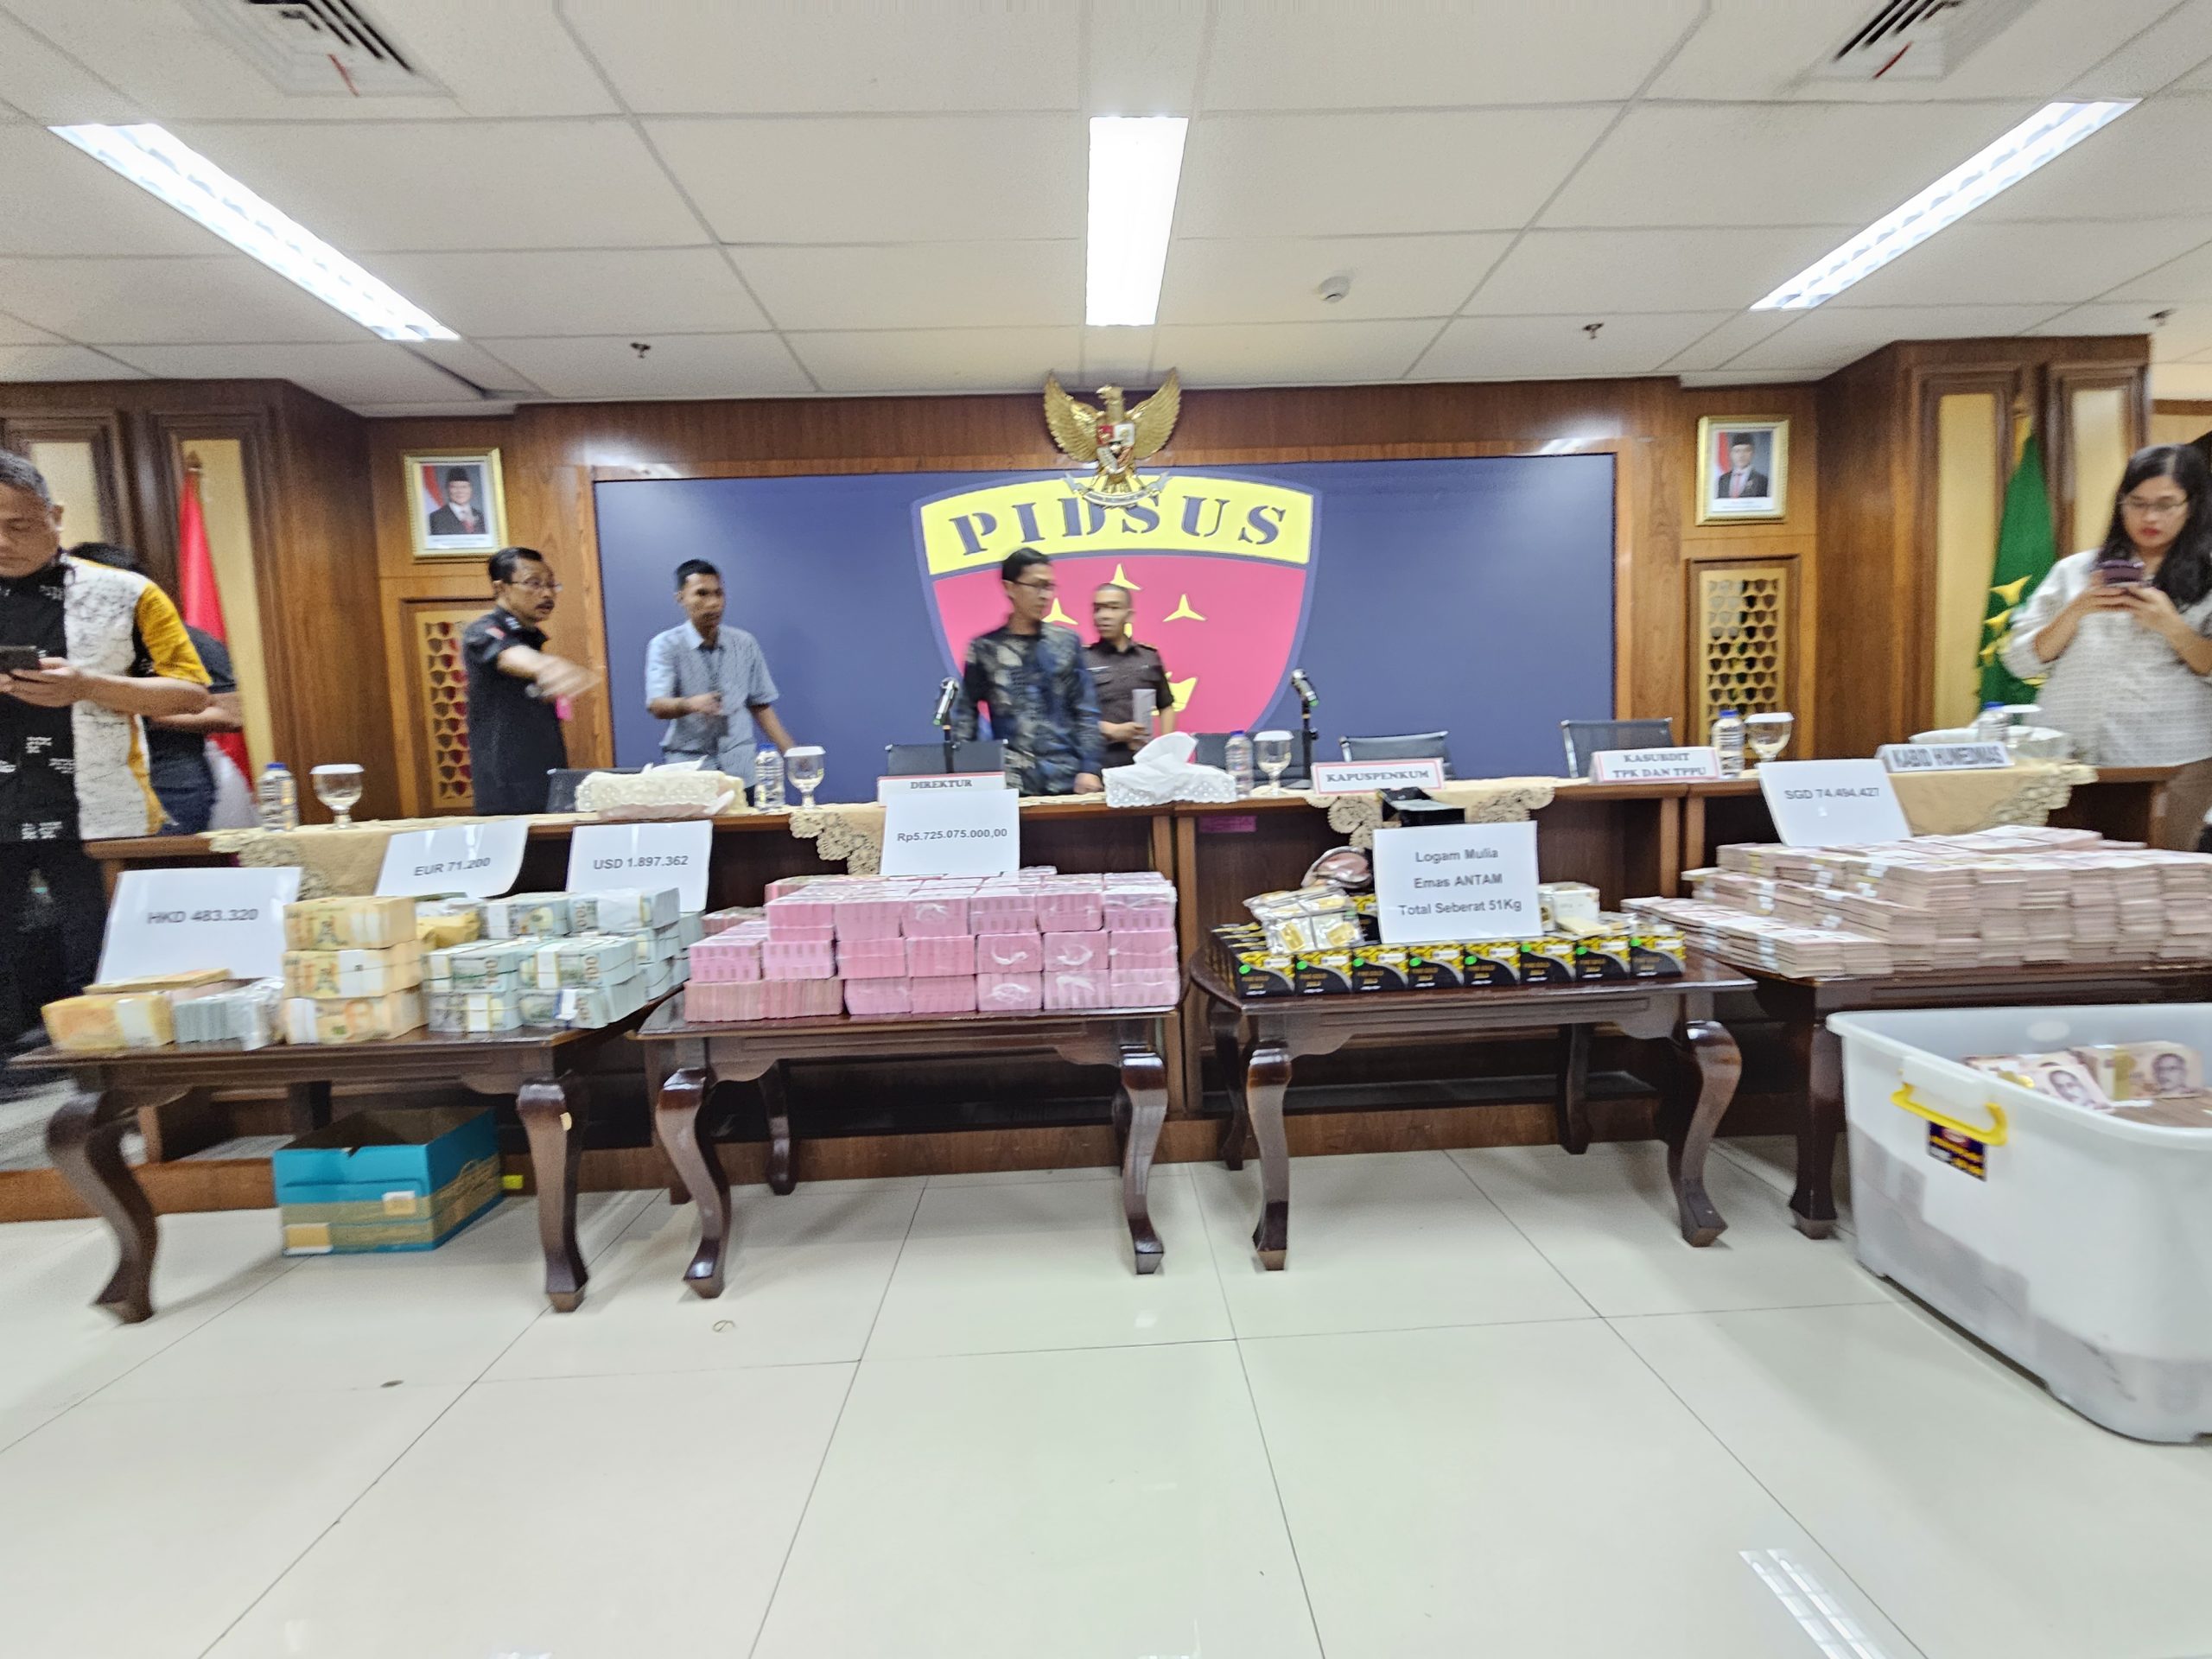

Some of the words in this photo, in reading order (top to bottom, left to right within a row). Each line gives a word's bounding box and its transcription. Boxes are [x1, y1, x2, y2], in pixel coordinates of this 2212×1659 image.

[949, 495, 1287, 556] PIDSUS
[1325, 770, 1429, 783] KAPUSPENKUM
[910, 779, 972, 790] DIREKTUR
[1783, 789, 1814, 800] SGD
[897, 828, 1008, 842] Rp5.725.075.000,00
[593, 858, 623, 870] USD
[626, 855, 689, 868] 1.897.362
[1414, 851, 1460, 864] Logam
[1464, 848, 1499, 860] Mulia
[414, 864, 443, 876] EUR
[446, 857, 492, 871] 71.200
[1414, 876, 1451, 888] Emas
[1454, 873, 1503, 887] ANTAM
[1398, 903, 1432, 916] Total
[1434, 900, 1486, 913] Seberat
[1489, 899, 1522, 912] 51Kg
[147, 911, 187, 924] HKD
[189, 908, 258, 922] 483.320
